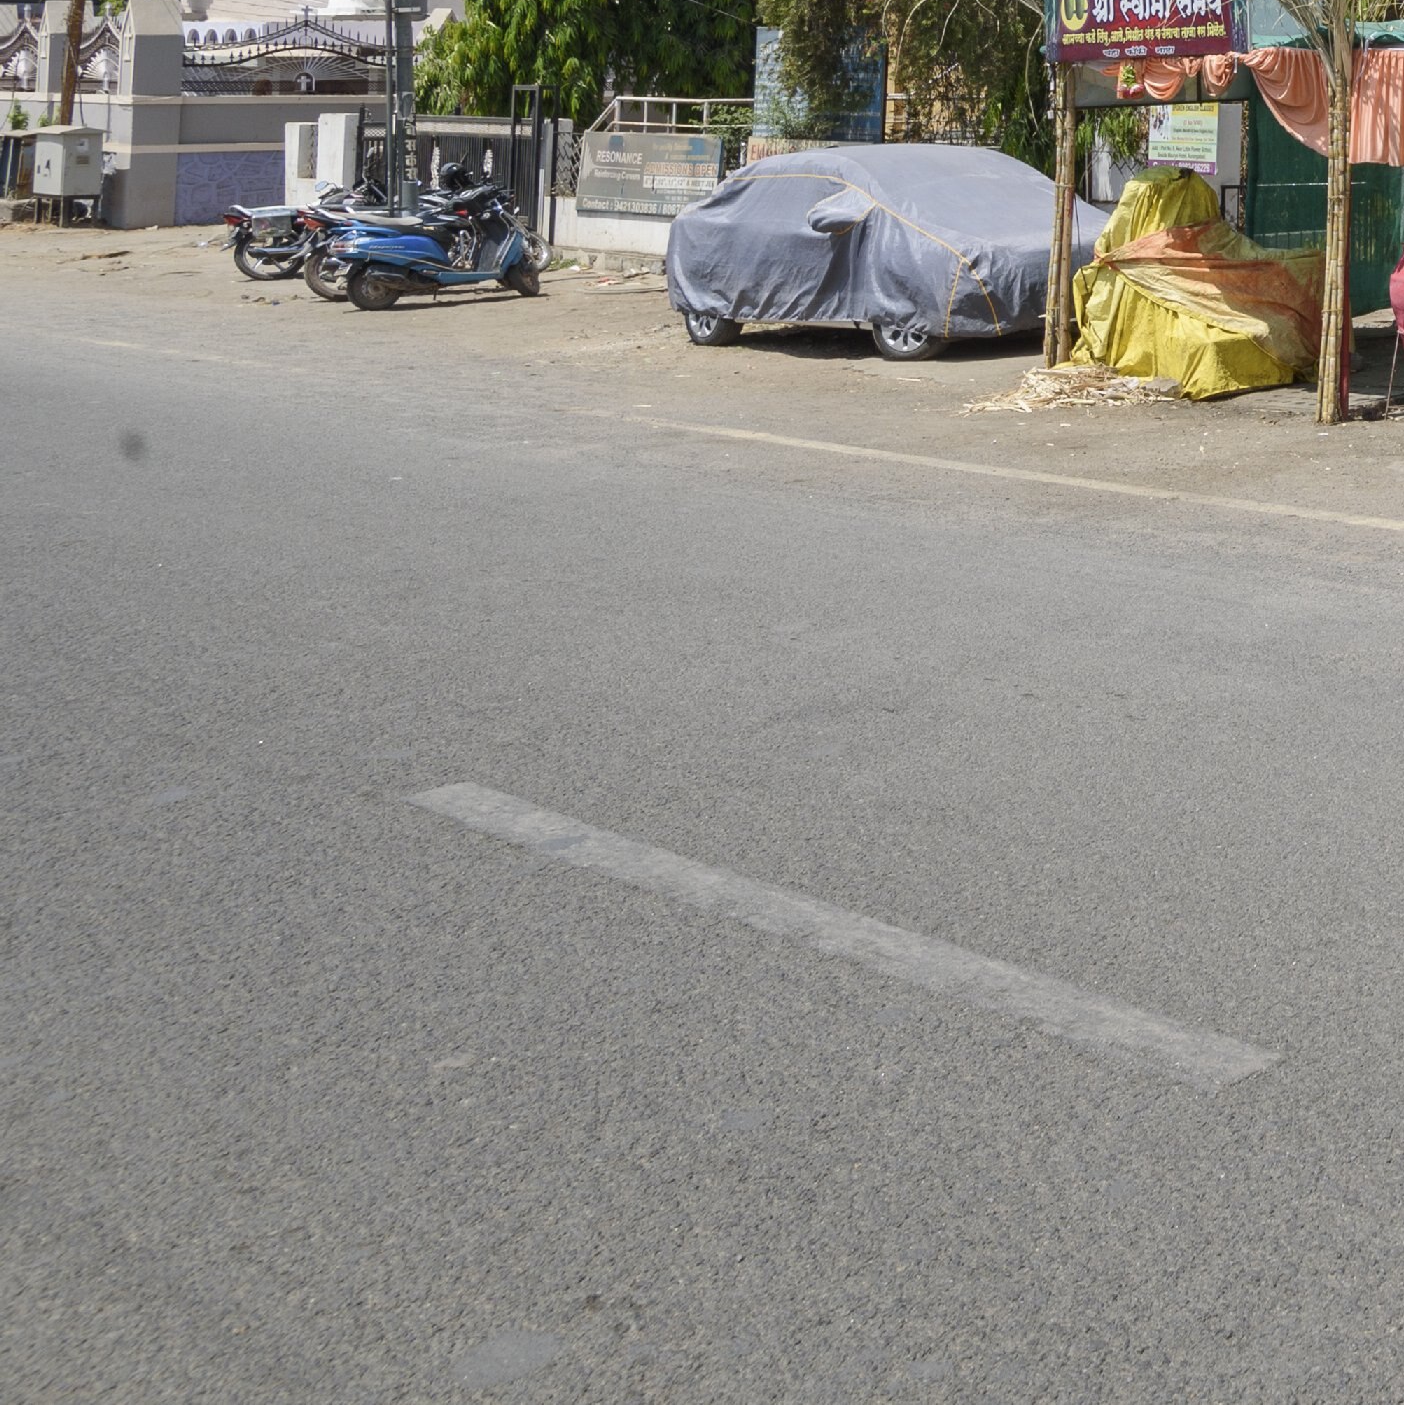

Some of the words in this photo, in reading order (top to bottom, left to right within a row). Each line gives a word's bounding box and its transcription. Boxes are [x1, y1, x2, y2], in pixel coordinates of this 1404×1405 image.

[596, 150, 643, 164] RESONANCE
[644, 162, 693, 176] ADMISSIONS
[694, 163, 717, 177] OPEN
[582, 197, 610, 210] Contact
